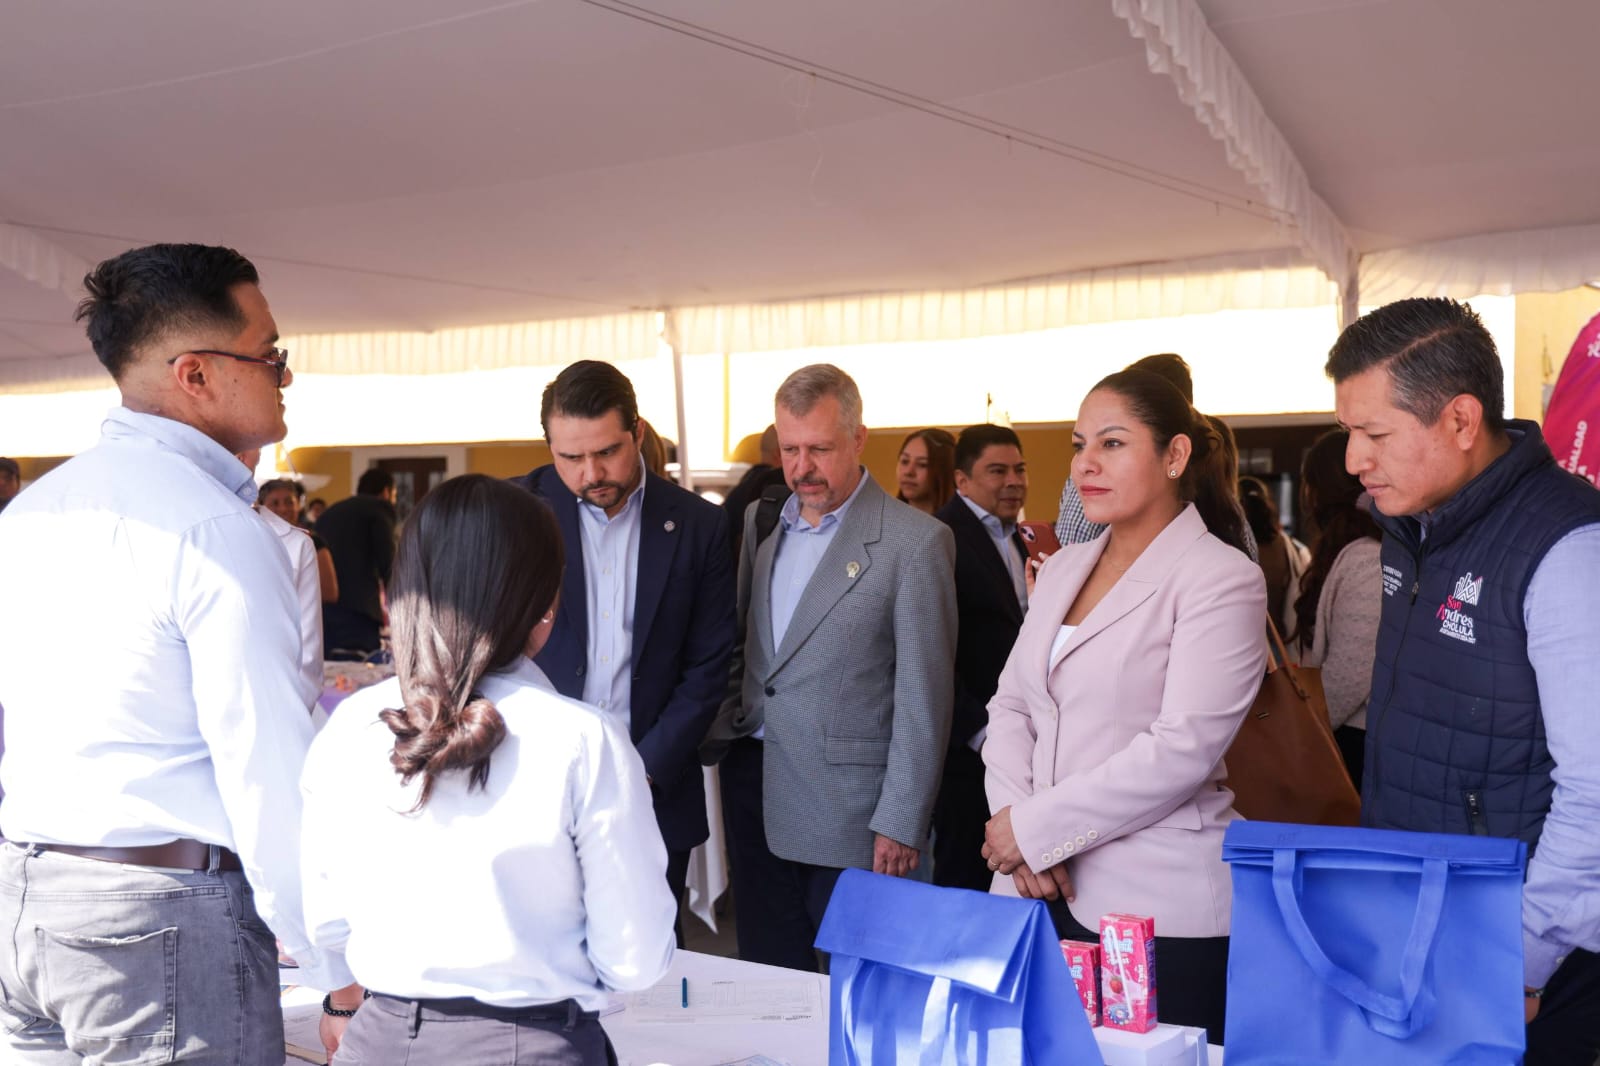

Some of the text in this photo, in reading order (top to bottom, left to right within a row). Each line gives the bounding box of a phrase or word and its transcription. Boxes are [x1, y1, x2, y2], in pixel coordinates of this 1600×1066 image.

[1568, 420, 1588, 474] UALDAD
[1447, 594, 1463, 611] San
[1442, 619, 1474, 637] CHOLULA
